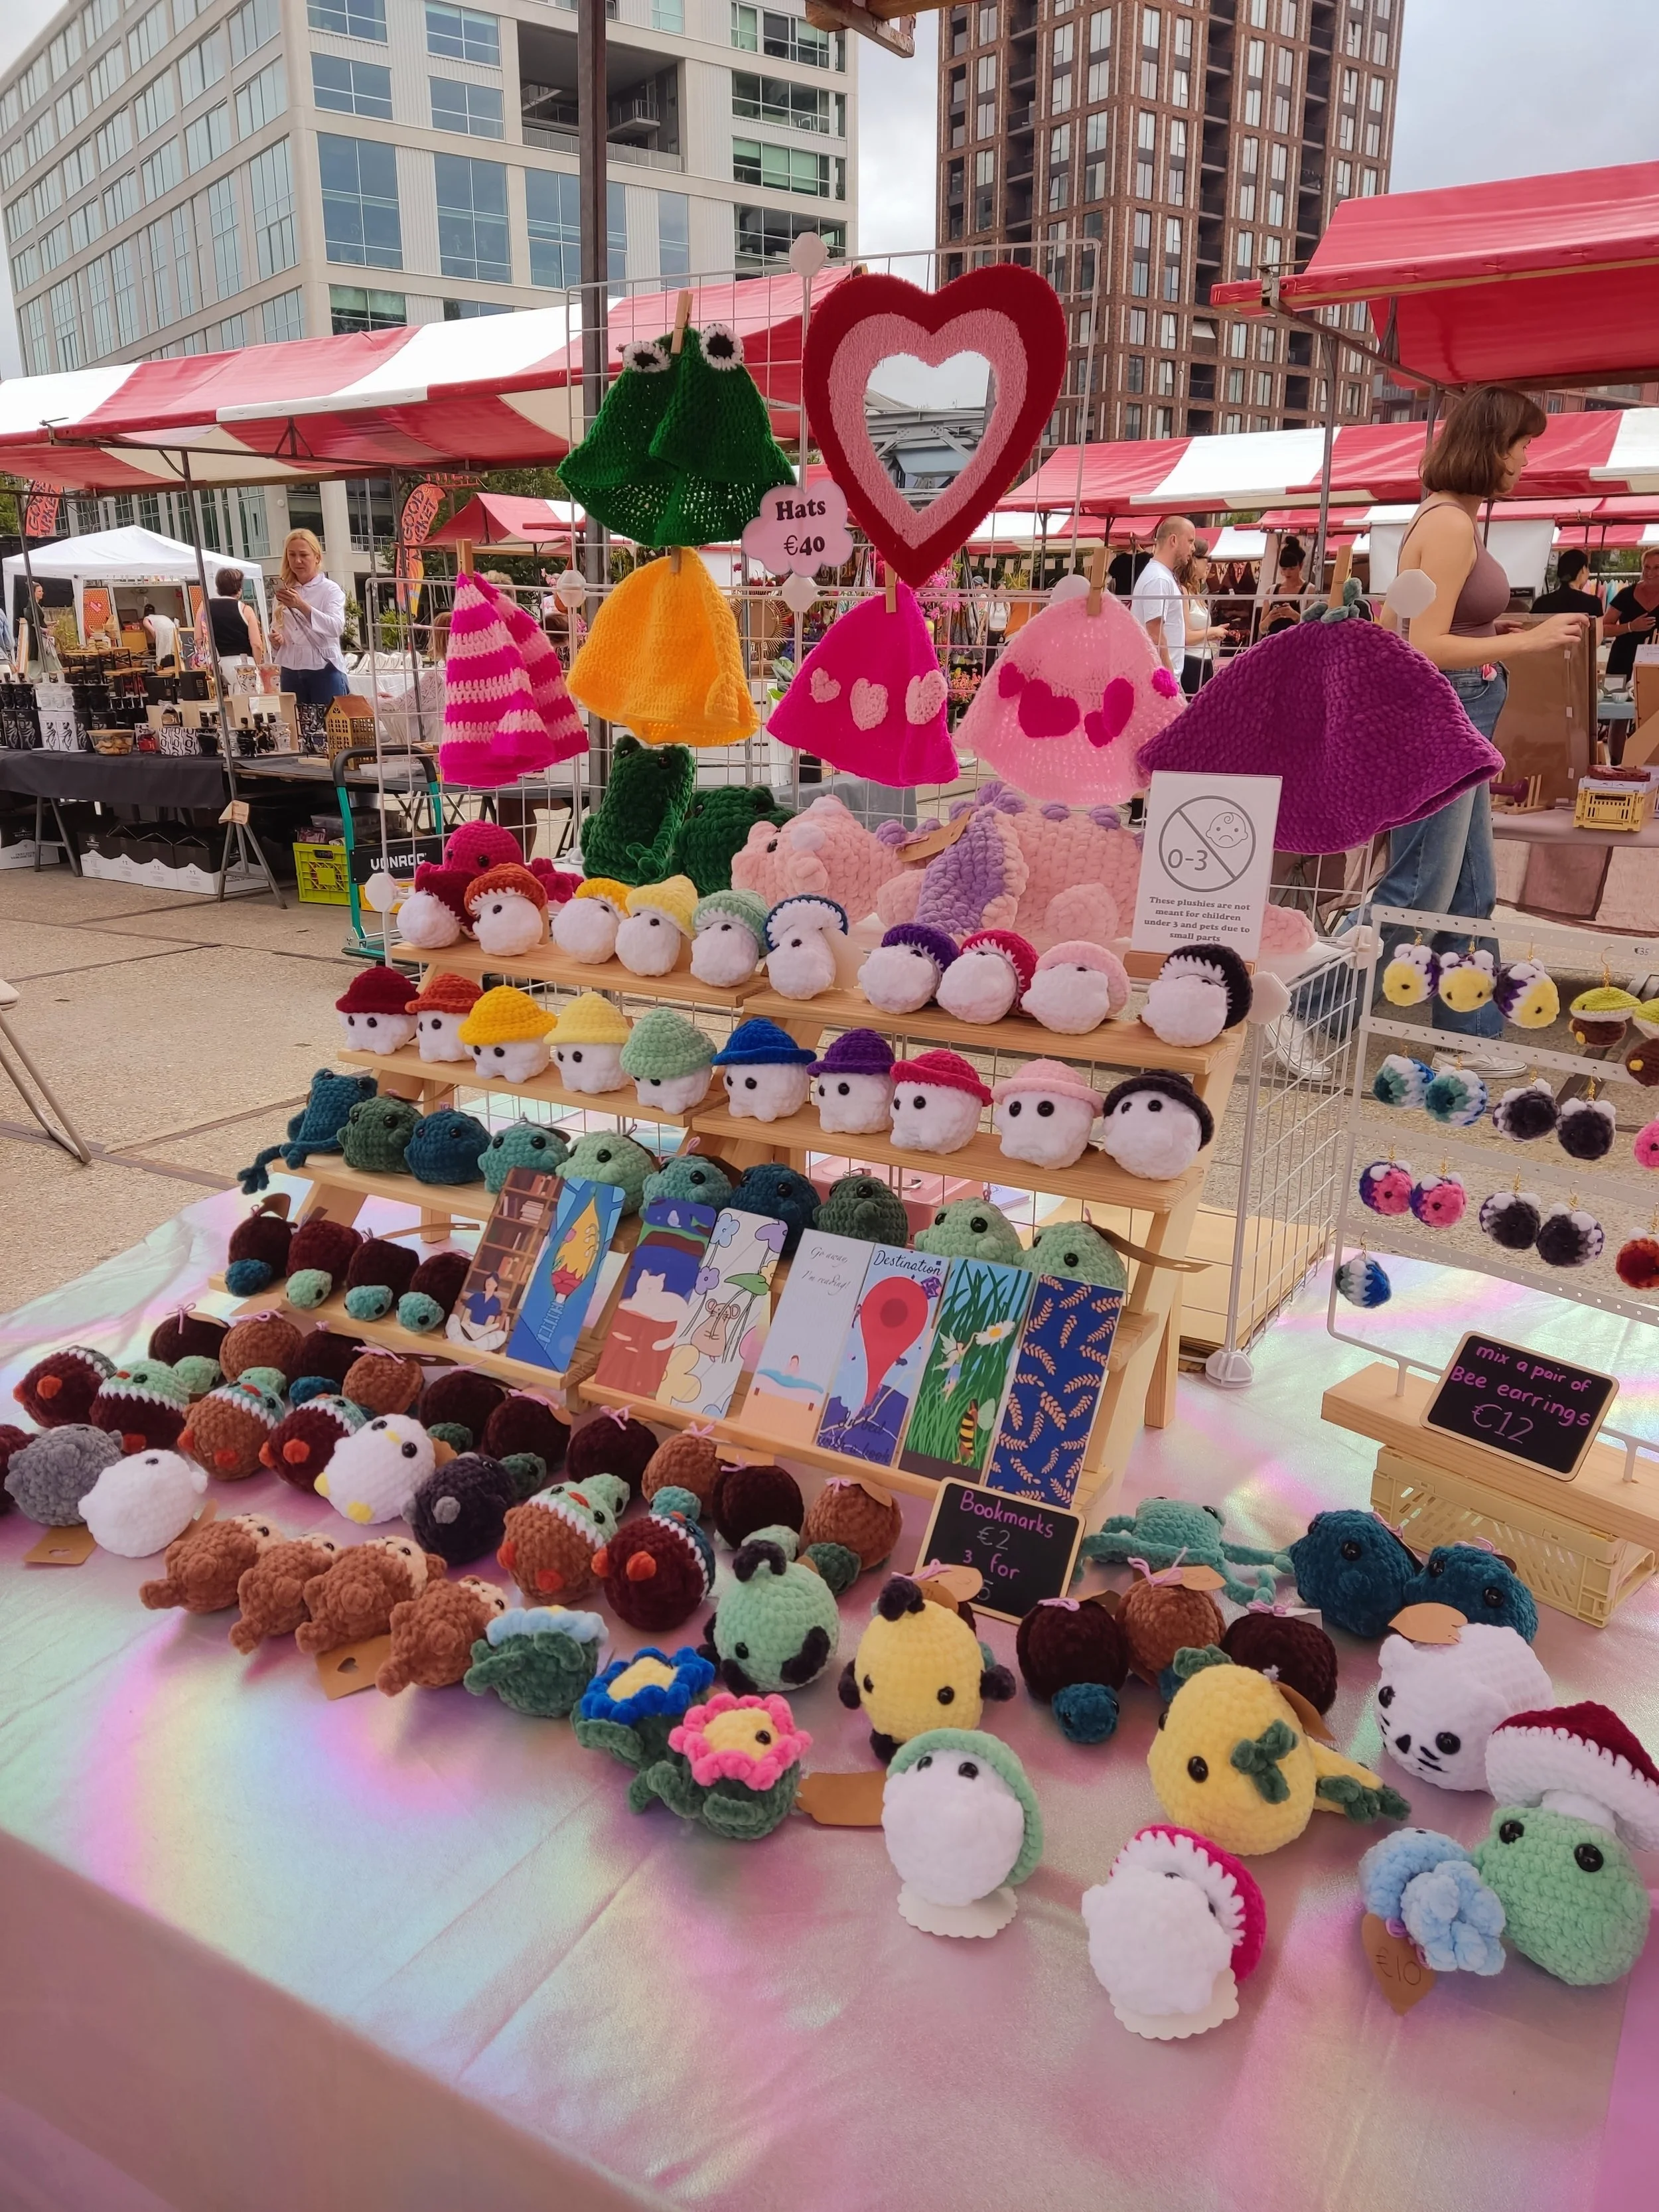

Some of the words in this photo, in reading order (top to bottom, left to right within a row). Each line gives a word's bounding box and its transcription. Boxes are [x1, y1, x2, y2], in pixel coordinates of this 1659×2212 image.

[775, 498, 826, 521] Hats
[783, 534, 825, 555] €40
[370, 853, 425, 870] VONROC
[1168, 848, 1208, 871] 0-3
[1149, 896, 1175, 905] These
[1177, 899, 1215, 909] plushies
[1199, 922, 1219, 931] pets
[1202, 912, 1241, 921] children
[1196, 934, 1220, 942] parts
[1634, 947, 1649, 956] €35
[810, 1246, 824, 1259] Go
[826, 1253, 848, 1268] away,
[873, 1250, 942, 1276] Destination
[802, 1270, 816, 1282] I'm
[818, 1272, 851, 1296] reading!
[1476, 1346, 1510, 1364] mix
[1516, 1361, 1528, 1372] a
[1530, 1365, 1567, 1382] pair
[1571, 1379, 1592, 1392] of
[1450, 1365, 1487, 1388] Bee
[1497, 1384, 1591, 1427] earrings
[1471, 1404, 1534, 1444] €12
[960, 1490, 1054, 1538] Bookmarks
[976, 1526, 1011, 1550] €2
[963, 1550, 972, 1563] 3
[990, 1553, 1020, 1580] for
[1376, 1947, 1421, 1986] €10
